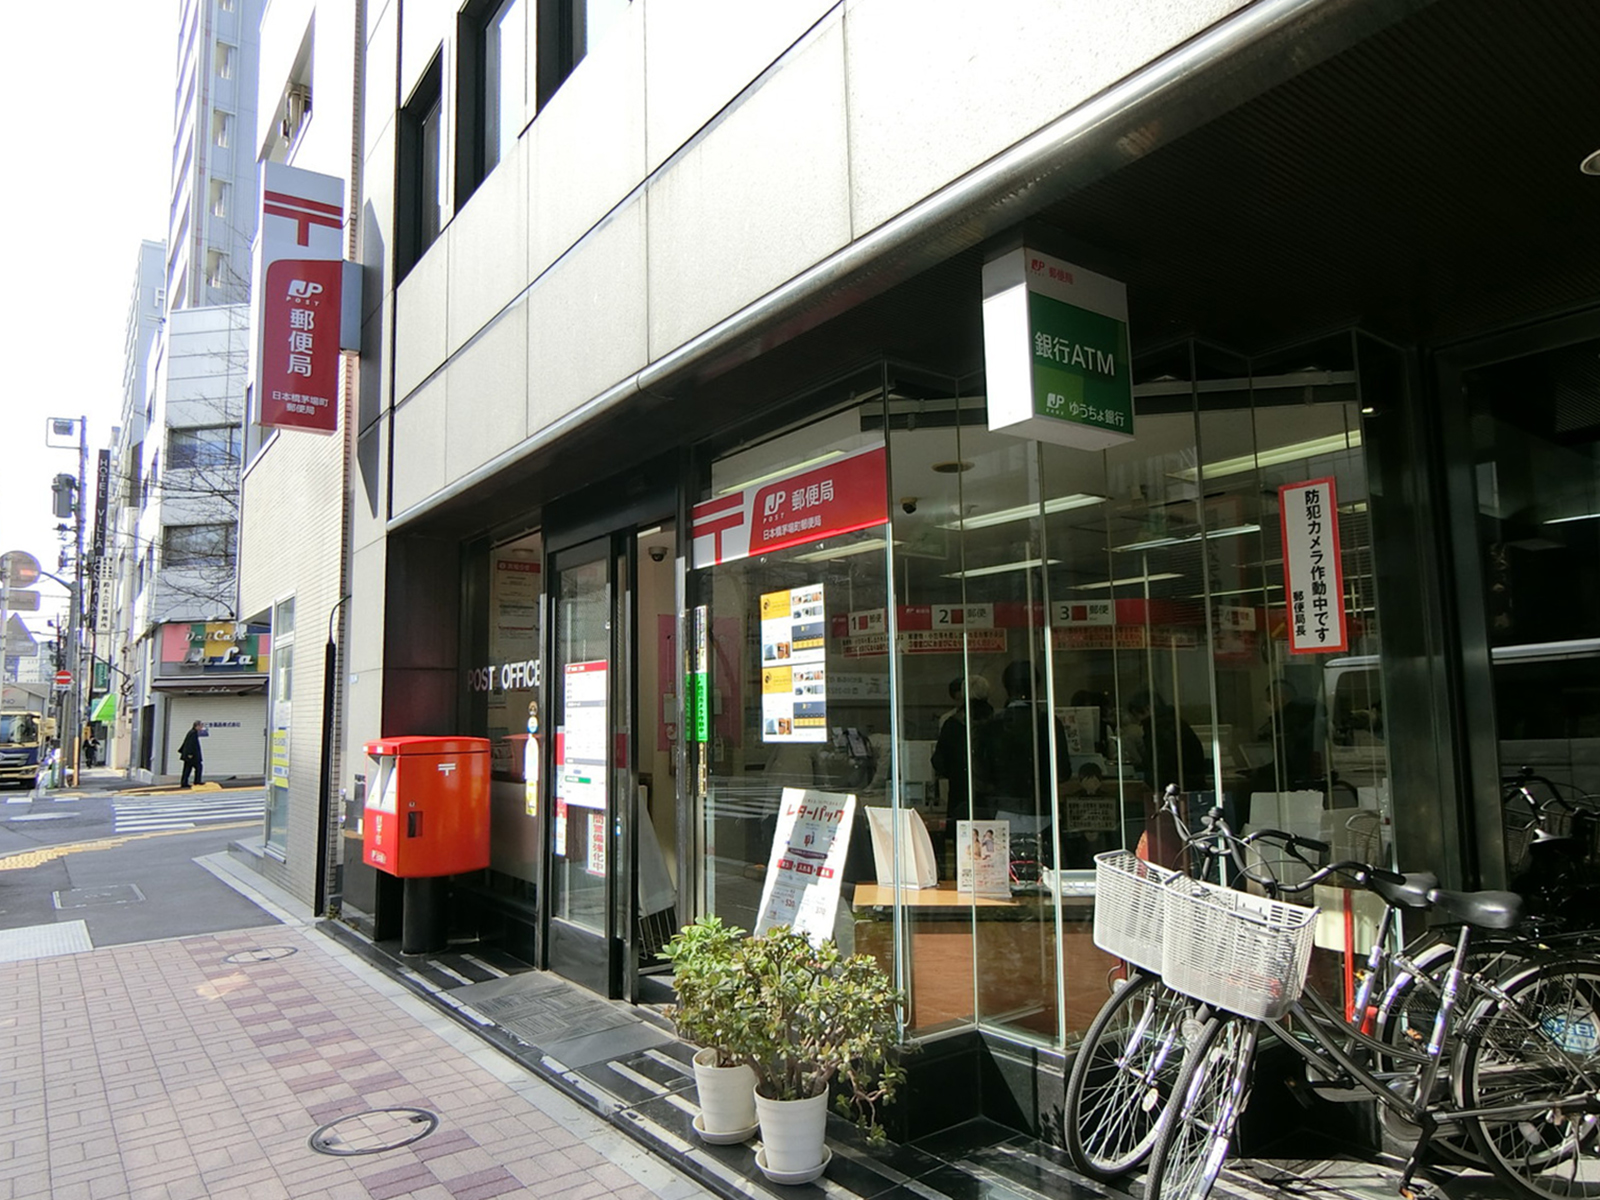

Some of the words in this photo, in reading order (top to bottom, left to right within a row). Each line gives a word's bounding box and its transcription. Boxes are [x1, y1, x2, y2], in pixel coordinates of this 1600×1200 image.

[1048, 266, 1074, 285] 郵便局
[286, 296, 320, 306] POST
[287, 308, 314, 378] 郵便局
[1035, 332, 1115, 376] 銀行ATM
[285, 402, 316, 416] 郵便局
[1069, 401, 1124, 427] ゆうちょ銀行
[99, 459, 107, 498] HOTEL
[791, 479, 834, 511] 郵便局
[763, 512, 785, 524] POST
[96, 509, 105, 548] VILLA
[1304, 489, 1330, 643] 防犯カメラ作動中です
[869, 613, 882, 624] 郵便
[939, 609, 949, 623] 2
[967, 608, 986, 618] 郵便
[1060, 606, 1070, 620] 3
[1089, 604, 1109, 615] 郵便
[1293, 591, 1306, 637] 郵便局長
[851, 617, 857, 630] 1
[213, 646, 253, 665] La
[467, 665, 496, 693] POST
[501, 659, 540, 690] OFFICE
[786, 804, 845, 824] レターパック
